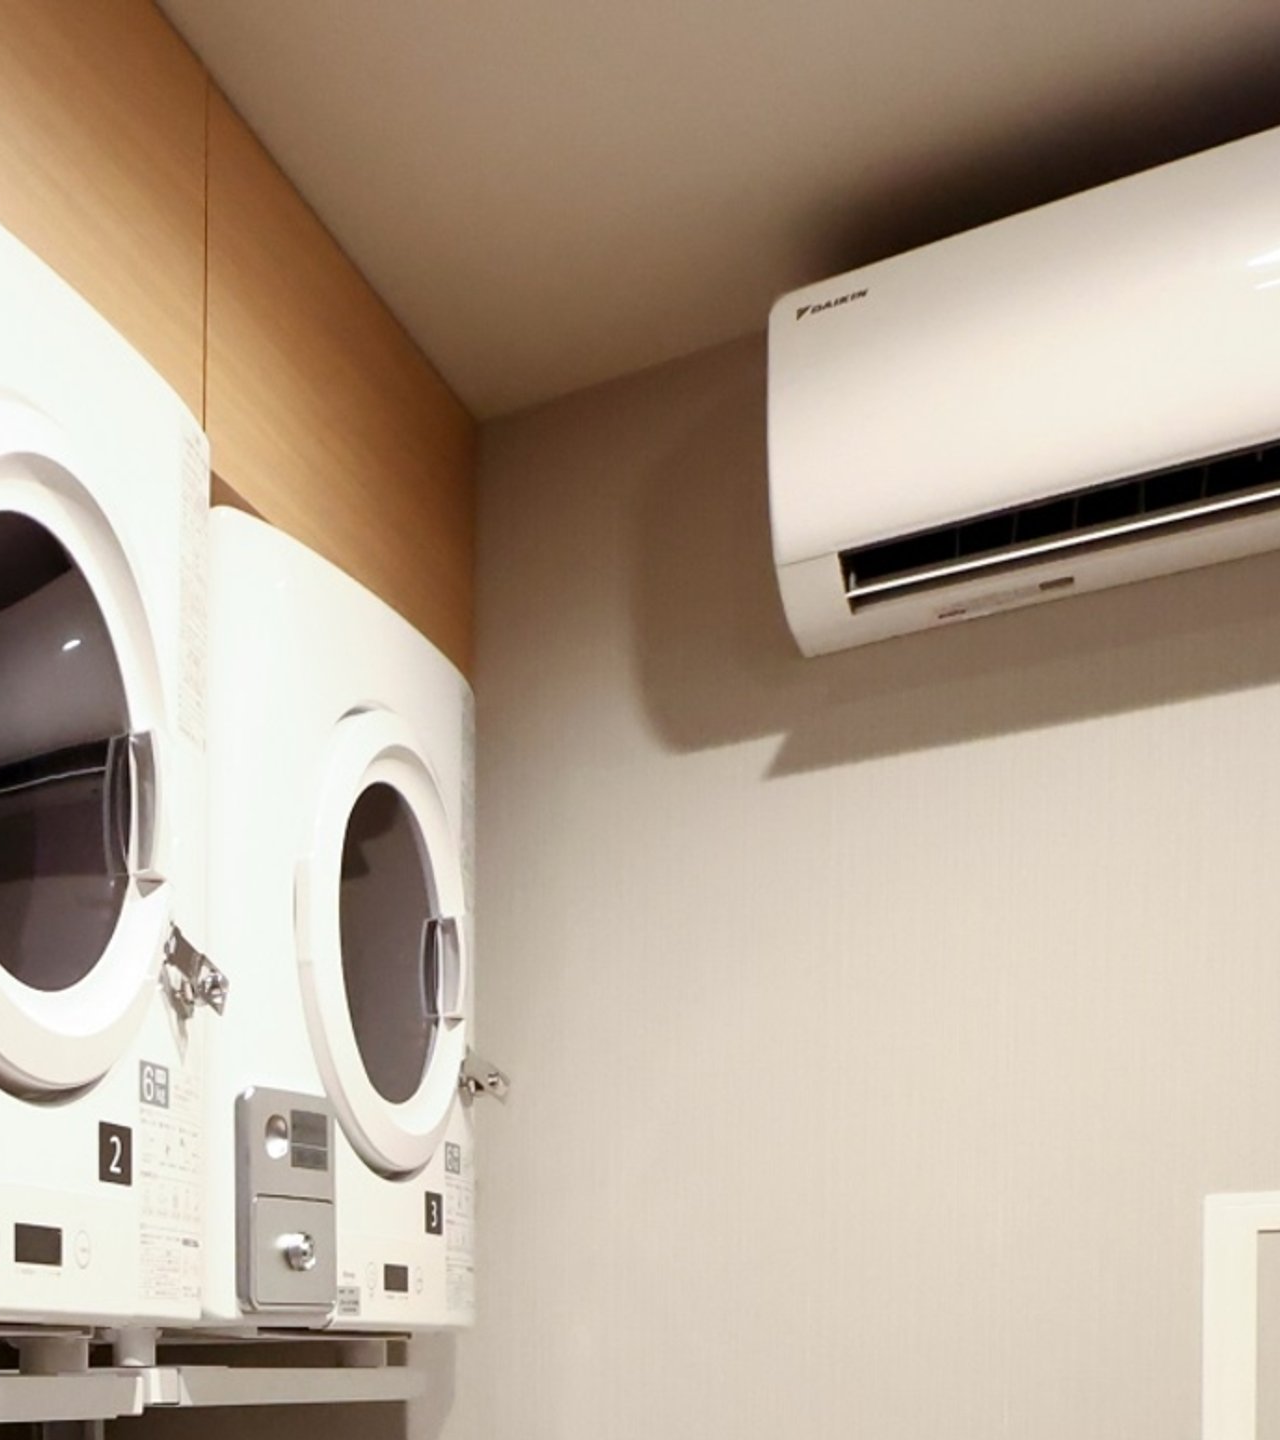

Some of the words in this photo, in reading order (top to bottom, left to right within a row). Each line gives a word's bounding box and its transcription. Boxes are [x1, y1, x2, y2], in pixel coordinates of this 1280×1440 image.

[810, 289, 868, 314] DAIKIN
[109, 1135, 122, 1174] 2
[431, 1200, 438, 1228] 3
